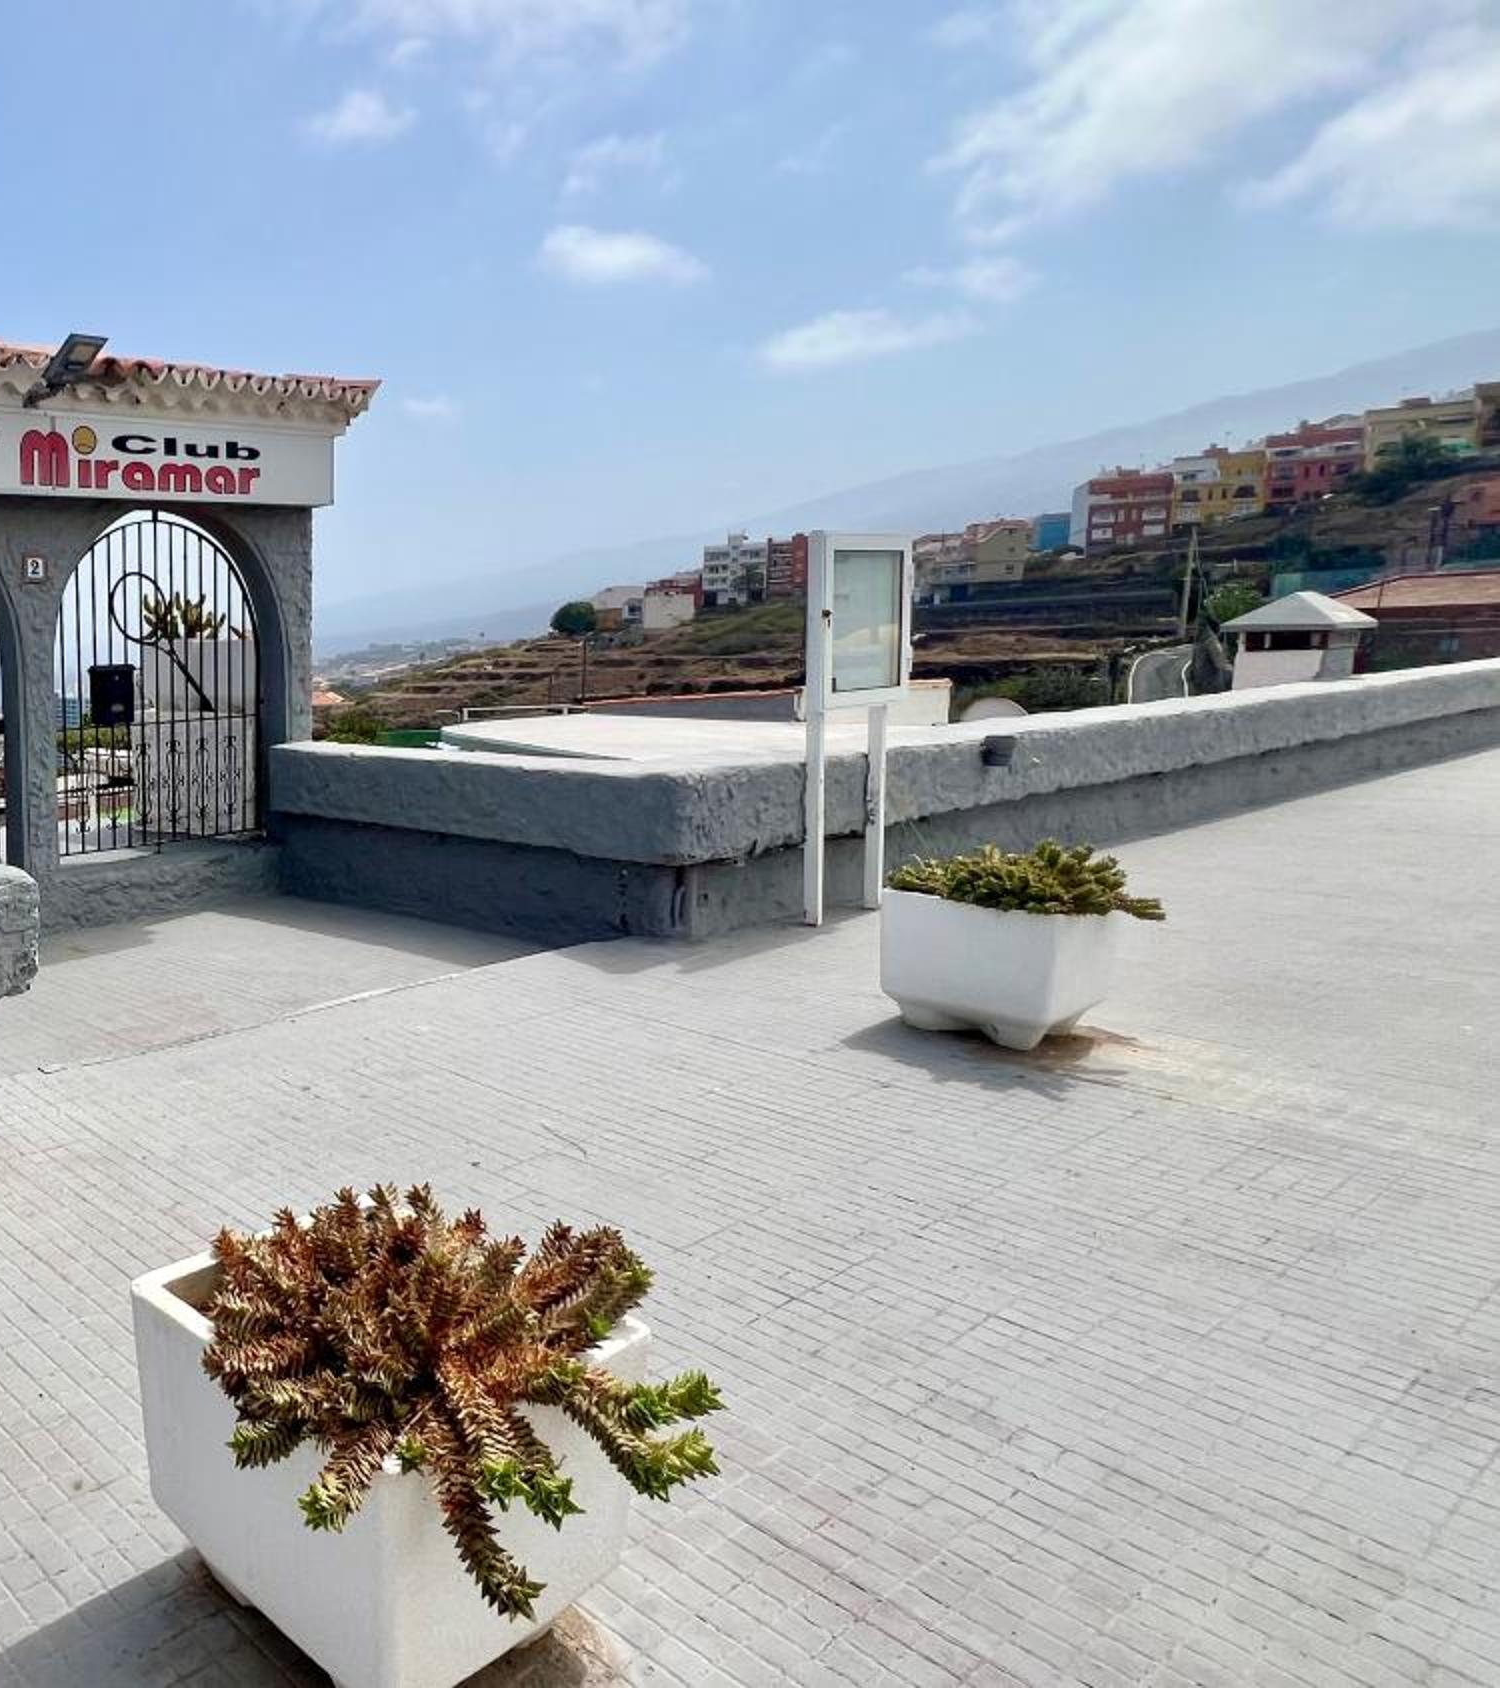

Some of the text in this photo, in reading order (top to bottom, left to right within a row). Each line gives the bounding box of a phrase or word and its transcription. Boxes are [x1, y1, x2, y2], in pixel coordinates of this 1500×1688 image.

[20, 425, 260, 494] Miramar
[111, 434, 261, 461] Club
[29, 559, 41, 576] 2
